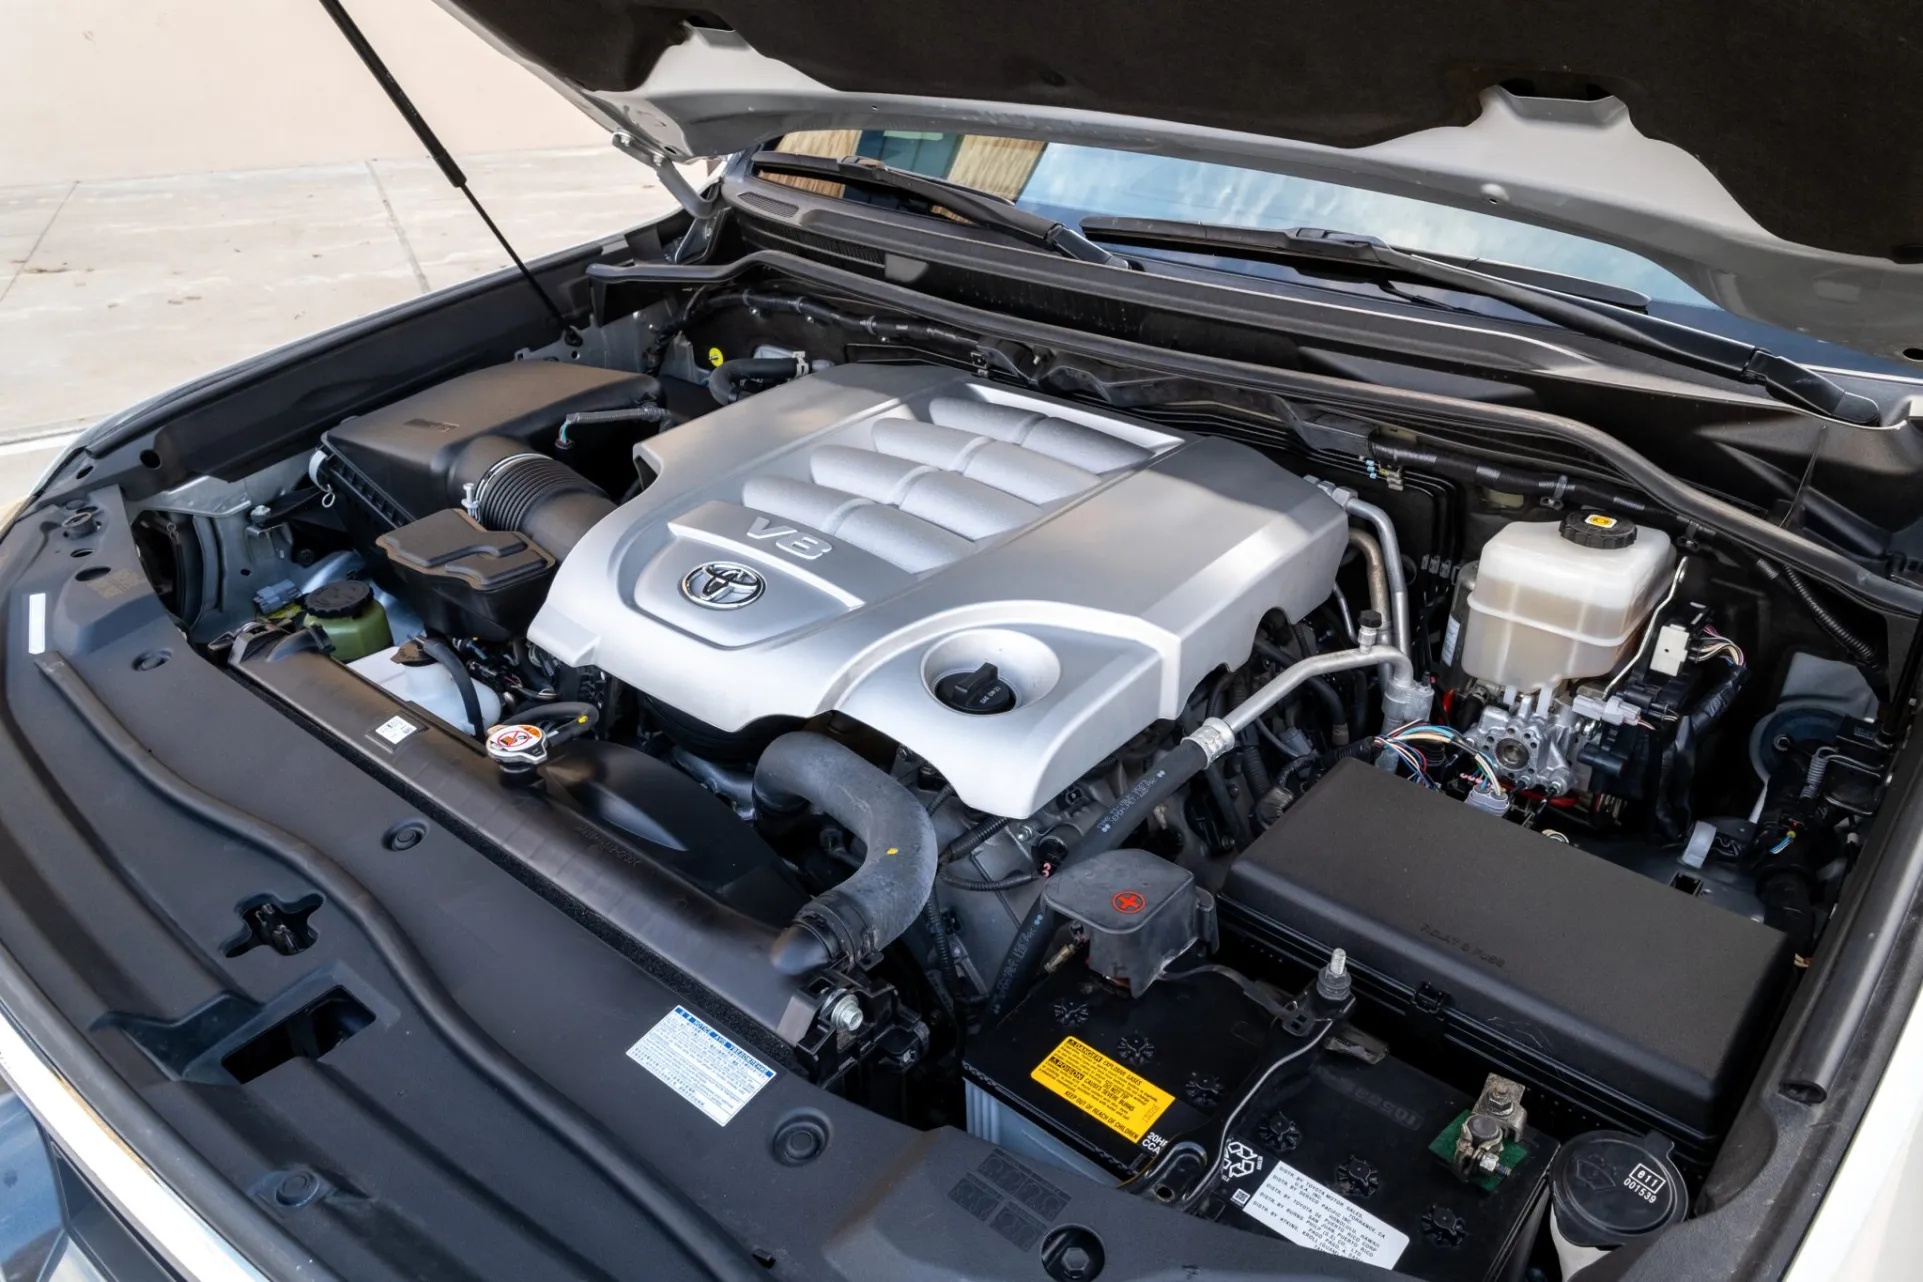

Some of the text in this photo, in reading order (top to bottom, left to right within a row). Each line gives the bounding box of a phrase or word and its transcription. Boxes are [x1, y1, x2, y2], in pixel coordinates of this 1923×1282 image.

[746, 516, 832, 560] V8
[1056, 1061, 1084, 1080] POISON
[1076, 1098, 1087, 1106] OUT
[1092, 1108, 1109, 1120] REACH
[1114, 1122, 1140, 1140] CHILDREN
[1623, 1177, 1657, 1203] 001539
[1637, 1170, 1658, 1187] e11
[1306, 1182, 1326, 1196] TOYOTA
[1326, 1195, 1345, 1207] MOTOR
[1293, 1200, 1313, 1213] TOYOTA
[1324, 1219, 1345, 1233] PUERTO
[1347, 1232, 1361, 1242] RICO
[1321, 1204, 1342, 1218] PACIFIC
[1308, 1215, 1319, 1223] SAN
[1337, 1233, 1359, 1247] PUERTO
[1360, 1247, 1374, 1257] RICO
[1361, 1234, 1381, 1247] HAWAII
